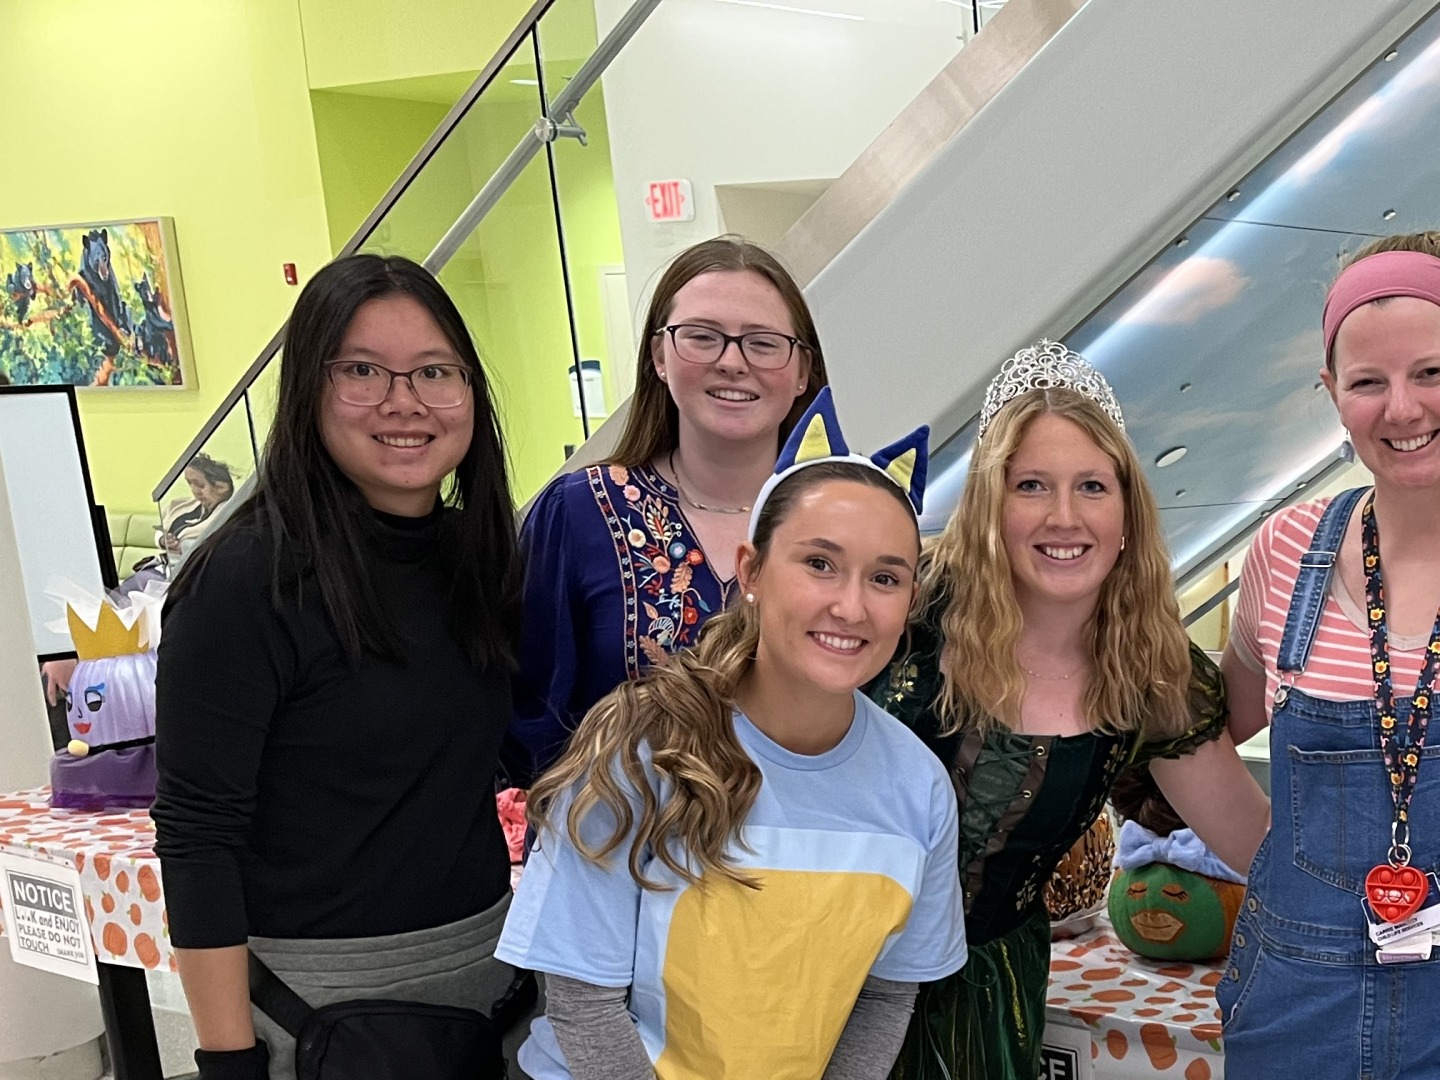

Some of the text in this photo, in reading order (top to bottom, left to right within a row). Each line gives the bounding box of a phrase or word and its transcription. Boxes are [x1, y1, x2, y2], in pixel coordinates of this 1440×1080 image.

[650, 182, 681, 218] EXIT
[13, 880, 73, 913] NOTICE
[18, 923, 80, 949] PLEASE DO NOT
[39, 915, 52, 928] and
[55, 915, 79, 935] ENJOY
[20, 936, 49, 952] TOUCH
